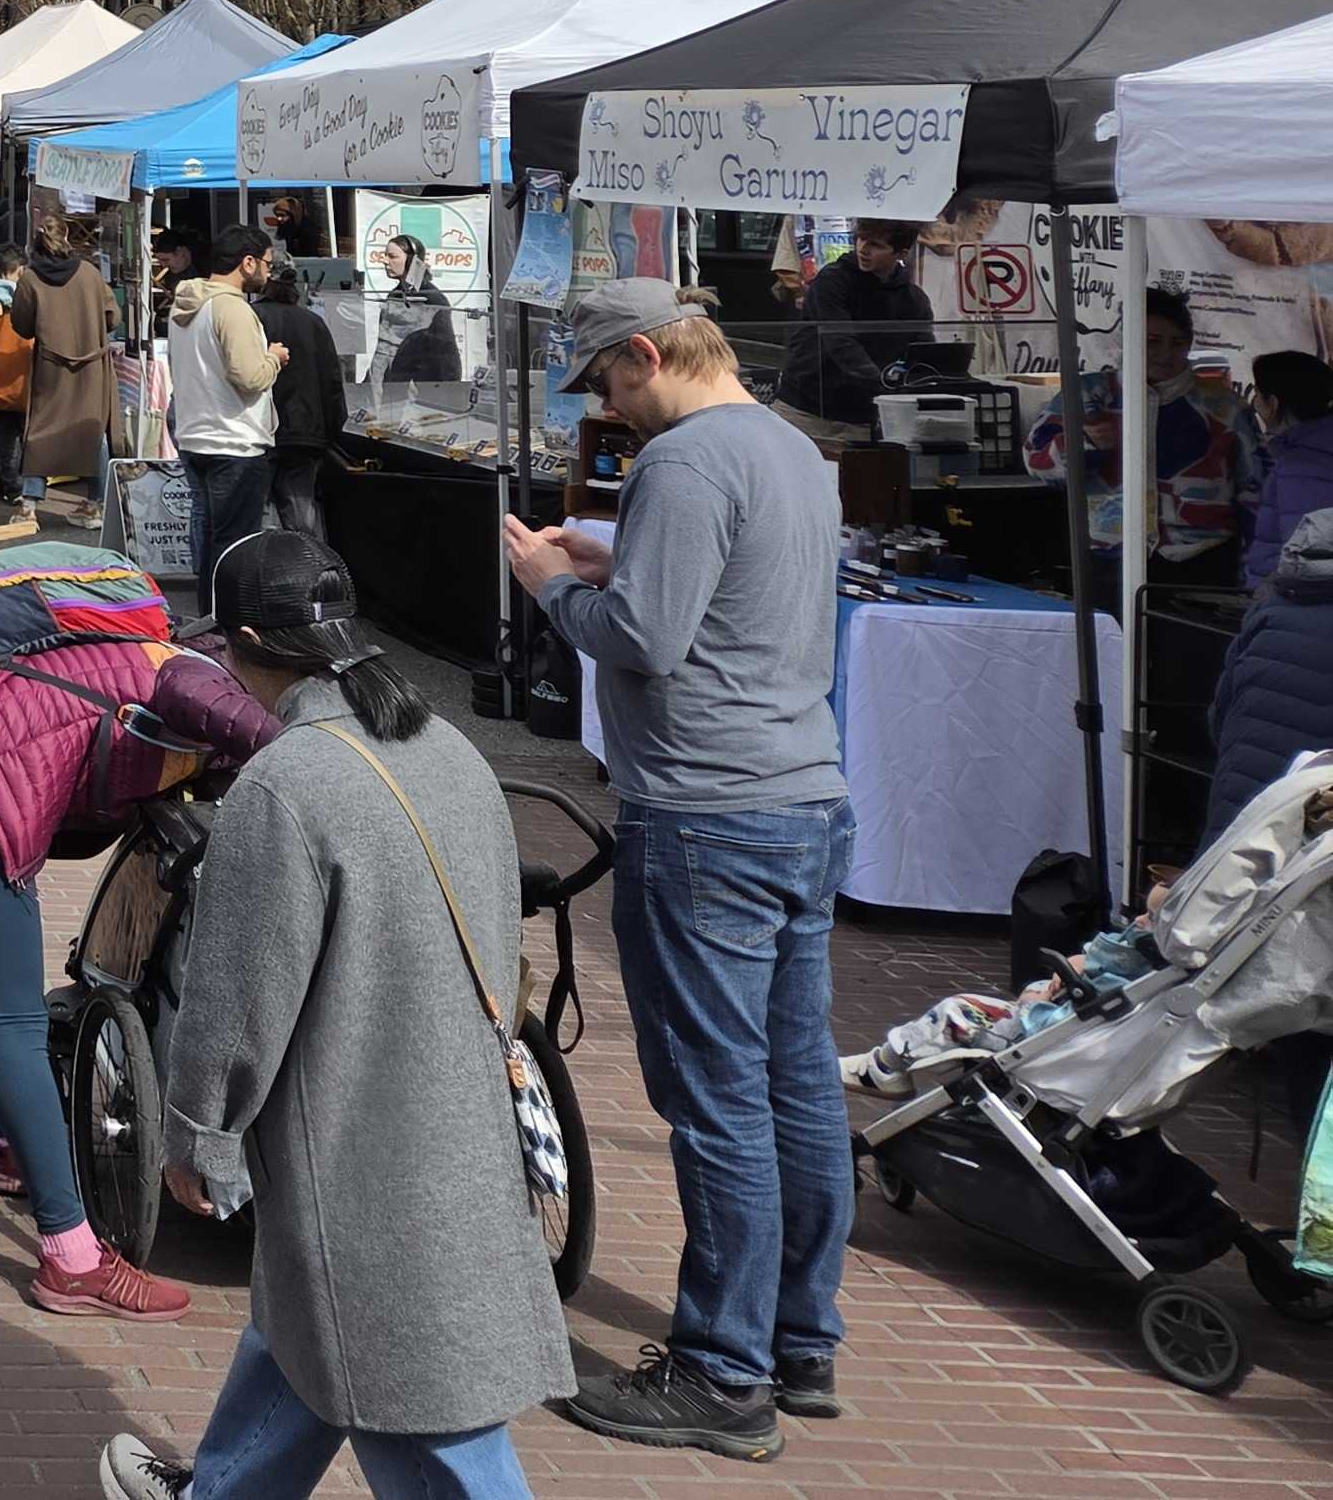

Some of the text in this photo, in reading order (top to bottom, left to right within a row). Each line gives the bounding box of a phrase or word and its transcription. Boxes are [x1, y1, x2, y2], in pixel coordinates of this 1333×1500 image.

[279, 83, 320, 132] Every Day
[323, 104, 346, 138] Good
[349, 94, 368, 130] Day
[424, 110, 459, 131] COOKIES
[643, 95, 963, 156] Shoyu Vinegar
[344, 140, 358, 178] for
[370, 112, 405, 150] Cookie
[585, 149, 829, 201] Miso Garum
[1035, 213, 1125, 251] COKIE
[435, 253, 473, 267] POPS
[583, 256, 610, 273] POPS
[1072, 266, 1116, 310] iffany
[144, 522, 187, 532] FRESHLY
[150, 534, 190, 545] JUST FO
